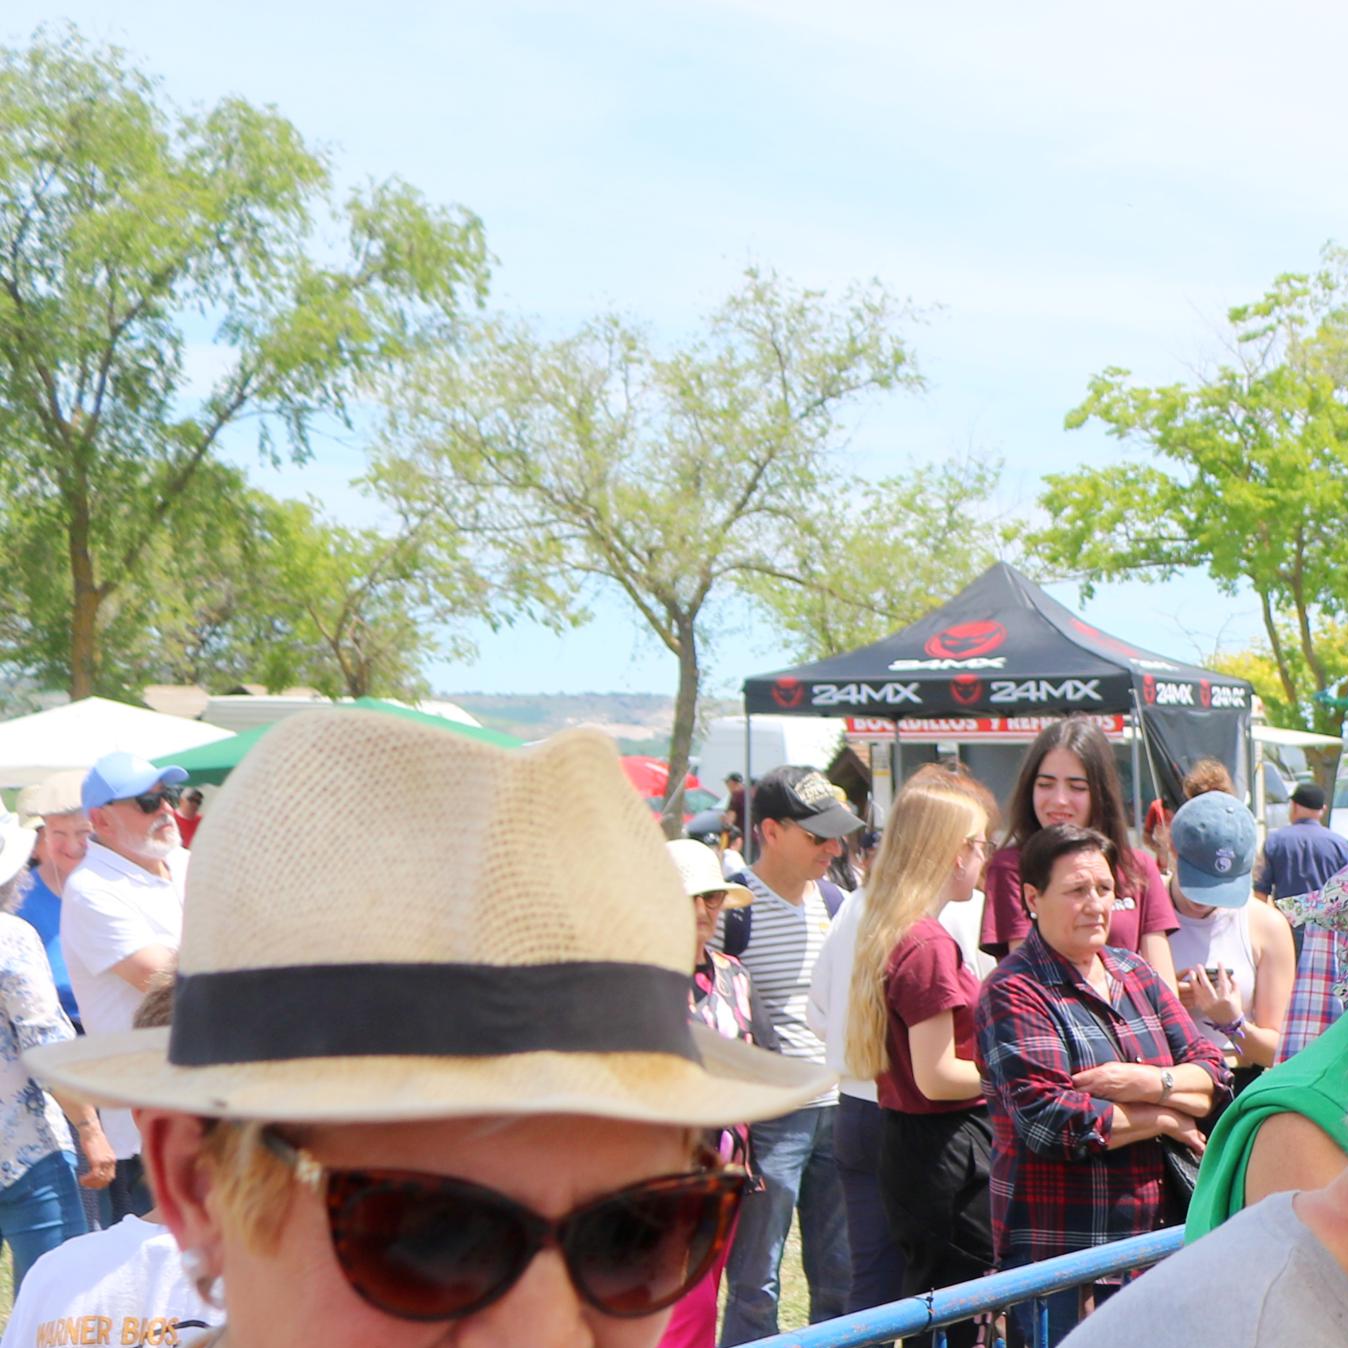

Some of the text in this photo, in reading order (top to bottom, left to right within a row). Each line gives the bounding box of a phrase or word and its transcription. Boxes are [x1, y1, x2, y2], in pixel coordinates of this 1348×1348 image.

[811, 679, 1103, 706] 24MX 24MX
[1155, 682, 1246, 708] 24MX 24MX
